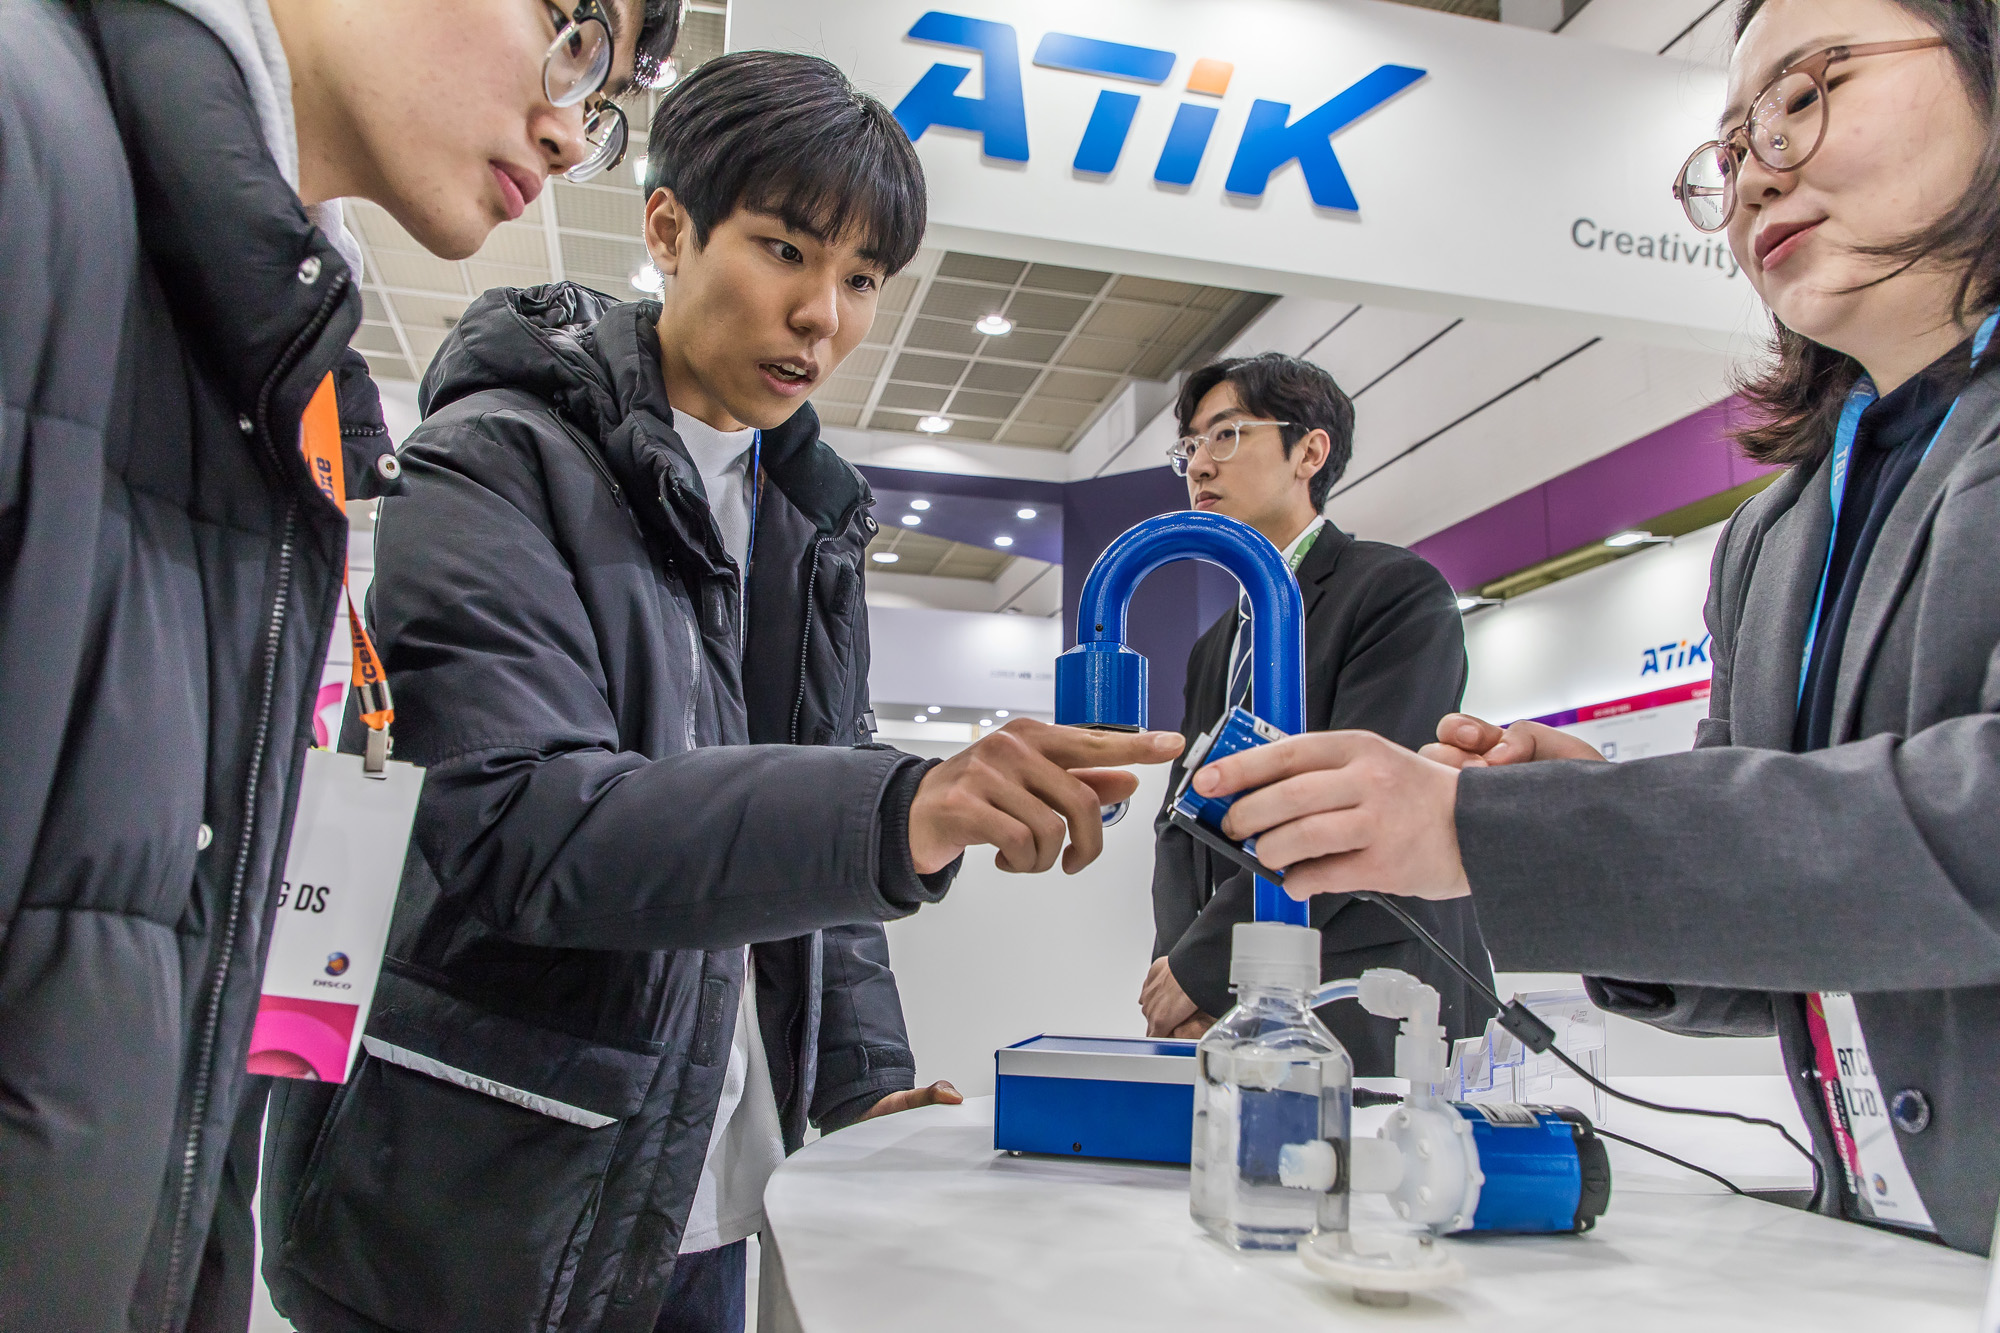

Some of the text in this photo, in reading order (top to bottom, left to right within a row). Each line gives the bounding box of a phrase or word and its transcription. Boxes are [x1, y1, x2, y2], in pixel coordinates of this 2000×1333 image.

[1571, 217, 1739, 278] Creativity
[1834, 445, 1849, 486] TEL
[294, 884, 331, 913] DS
[313, 979, 352, 991] DISCO
[1846, 1087, 1884, 1118] LTD.
